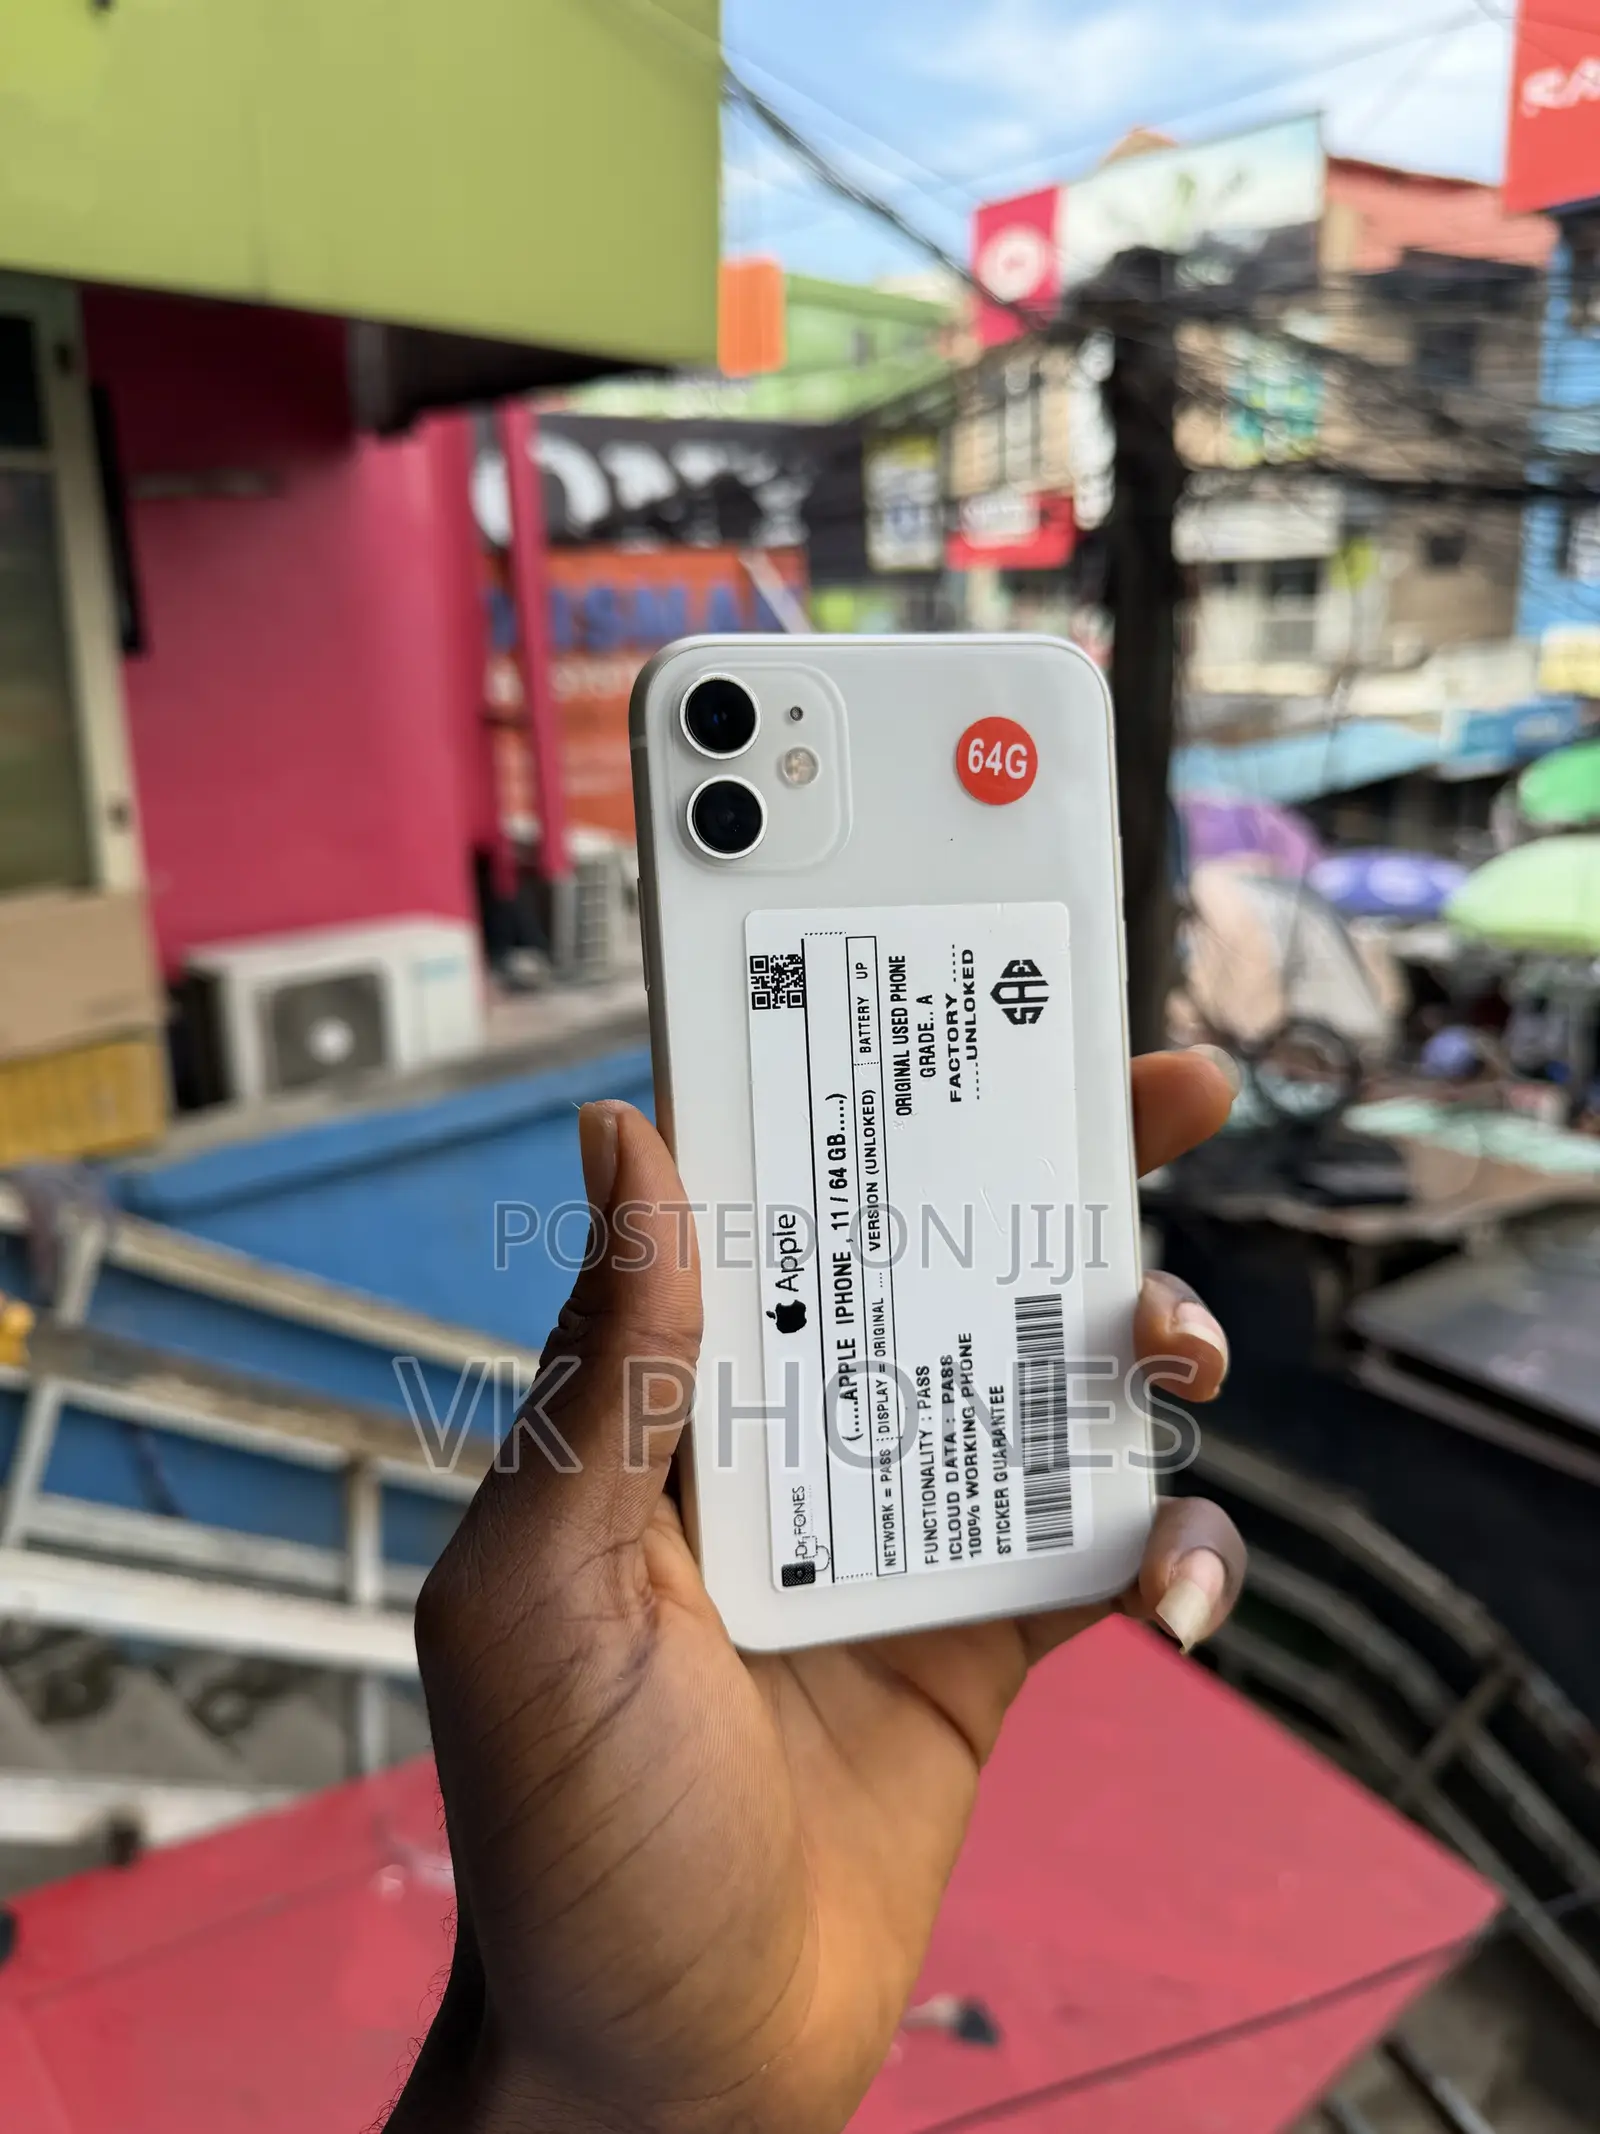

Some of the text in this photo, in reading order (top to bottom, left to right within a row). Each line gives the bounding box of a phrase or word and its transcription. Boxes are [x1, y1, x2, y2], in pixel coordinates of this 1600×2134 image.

[967, 738, 1028, 780] 64G
[855, 962, 872, 1053] BATTERY UP
[916, 995, 933, 1005] A
[888, 955, 912, 1116] ORIGINAL USED PHONE
[945, 993, 961, 1103] FACTORY
[829, 1167, 848, 1190] 64
[861, 1089, 881, 1251] VERSION (UNLOKED)
[831, 1211, 850, 1231] 11
[773, 1213, 803, 1292] Apple
[833, 1251, 855, 1324] IPHONE
[872, 1297, 887, 1357] ORIGINAL
[876, 1380, 890, 1434] DISPLAY
[915, 1365, 932, 1409] PASS
[940, 1354, 956, 1404] PASS
[879, 1448, 893, 1482] PASS
[943, 1432, 959, 1483] DATA
[959, 1333, 983, 1558] 100% WORKING PHONE
[989, 1385, 1012, 1555] STICKER GUARANTEE
[792, 1485, 807, 1535] FONES
[919, 1429, 939, 1564] FUNCTIONALITY
[941, 1491, 963, 1560] ICLOUD
[880, 1504, 897, 1567] NETWORK
